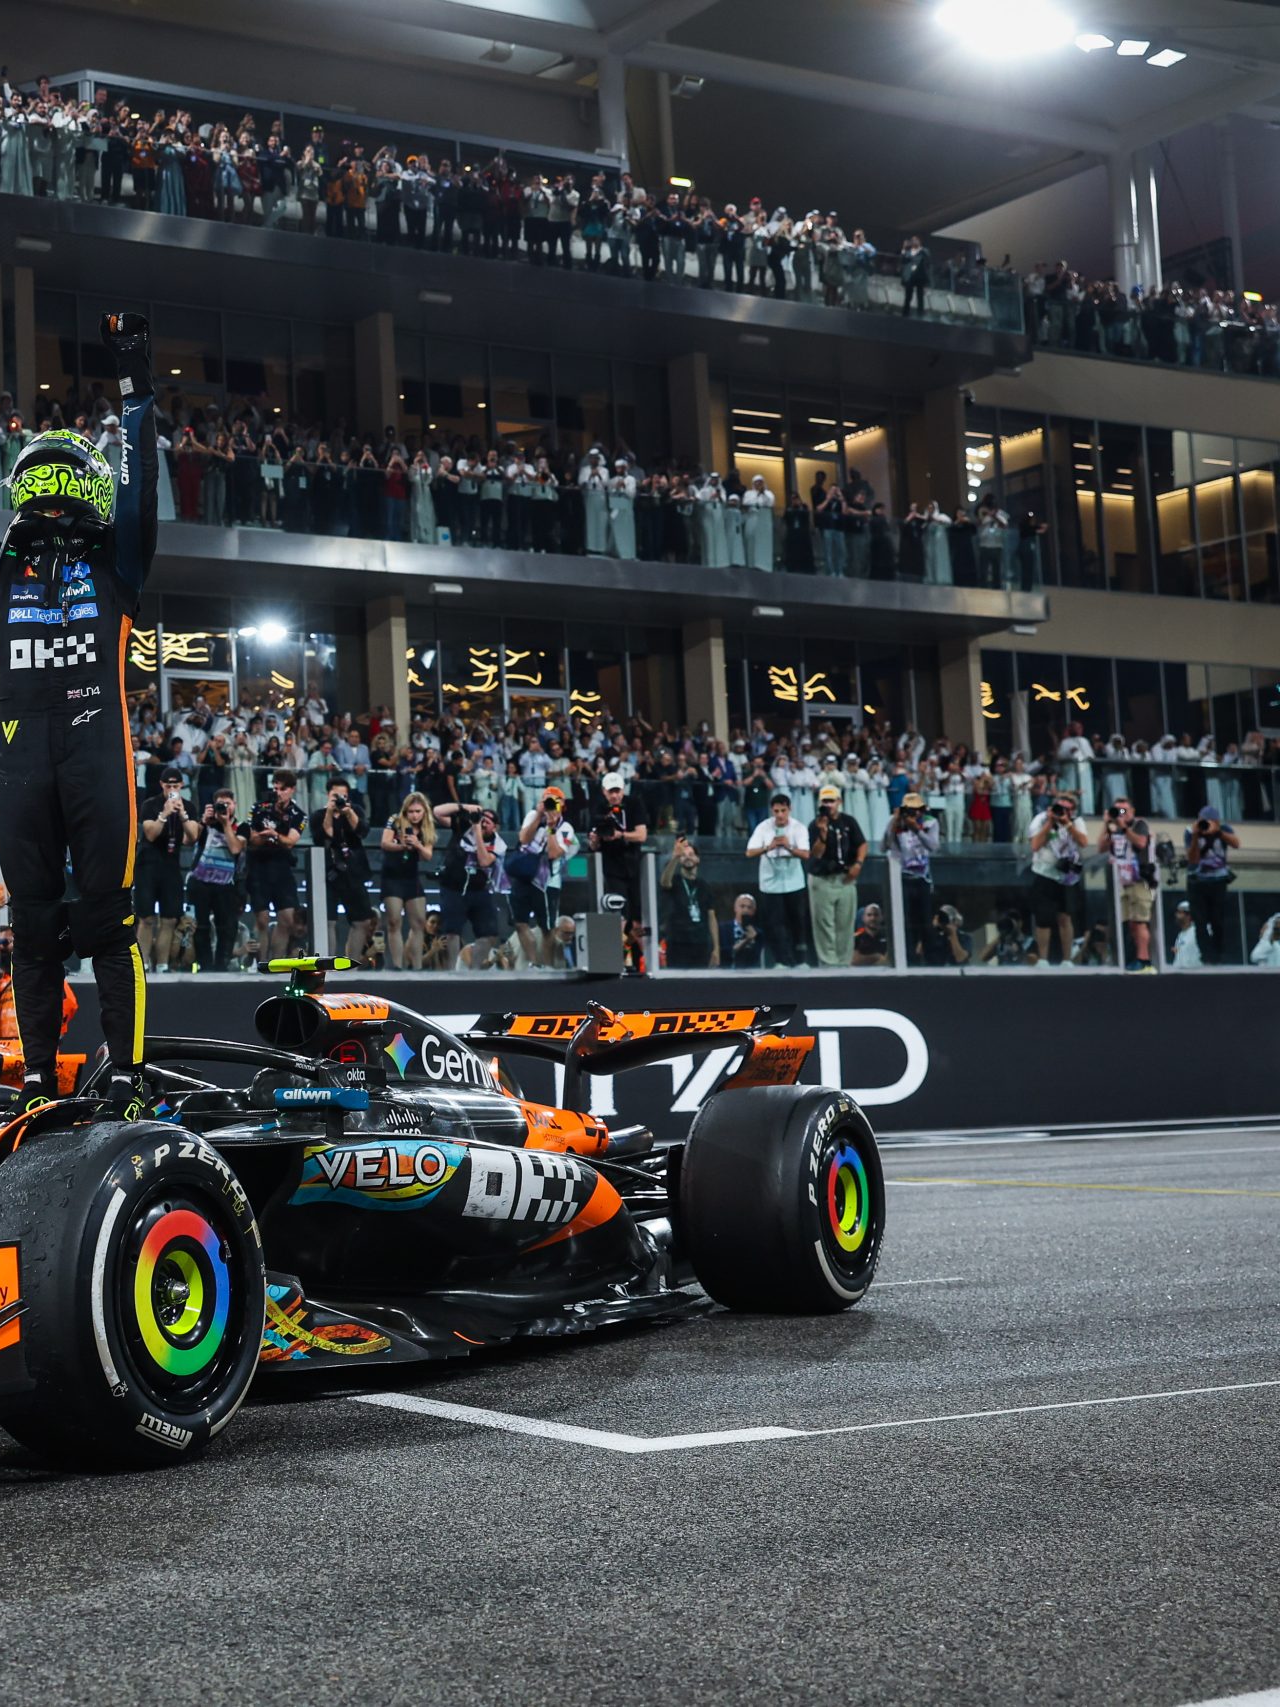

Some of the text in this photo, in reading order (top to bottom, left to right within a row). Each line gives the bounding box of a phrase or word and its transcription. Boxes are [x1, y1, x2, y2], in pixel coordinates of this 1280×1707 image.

[121, 428, 133, 486] allwyn
[10, 606, 94, 622] DELL Technogies
[10, 633, 97, 669] OKX
[346, 1068, 366, 1082] okta
[283, 1089, 332, 1103] allwyn
[154, 1141, 247, 1203] P ZERO
[315, 1146, 447, 1190] VELO
[808, 1104, 836, 1207] P ZERO
[135, 1412, 193, 1450] PIRELLI
